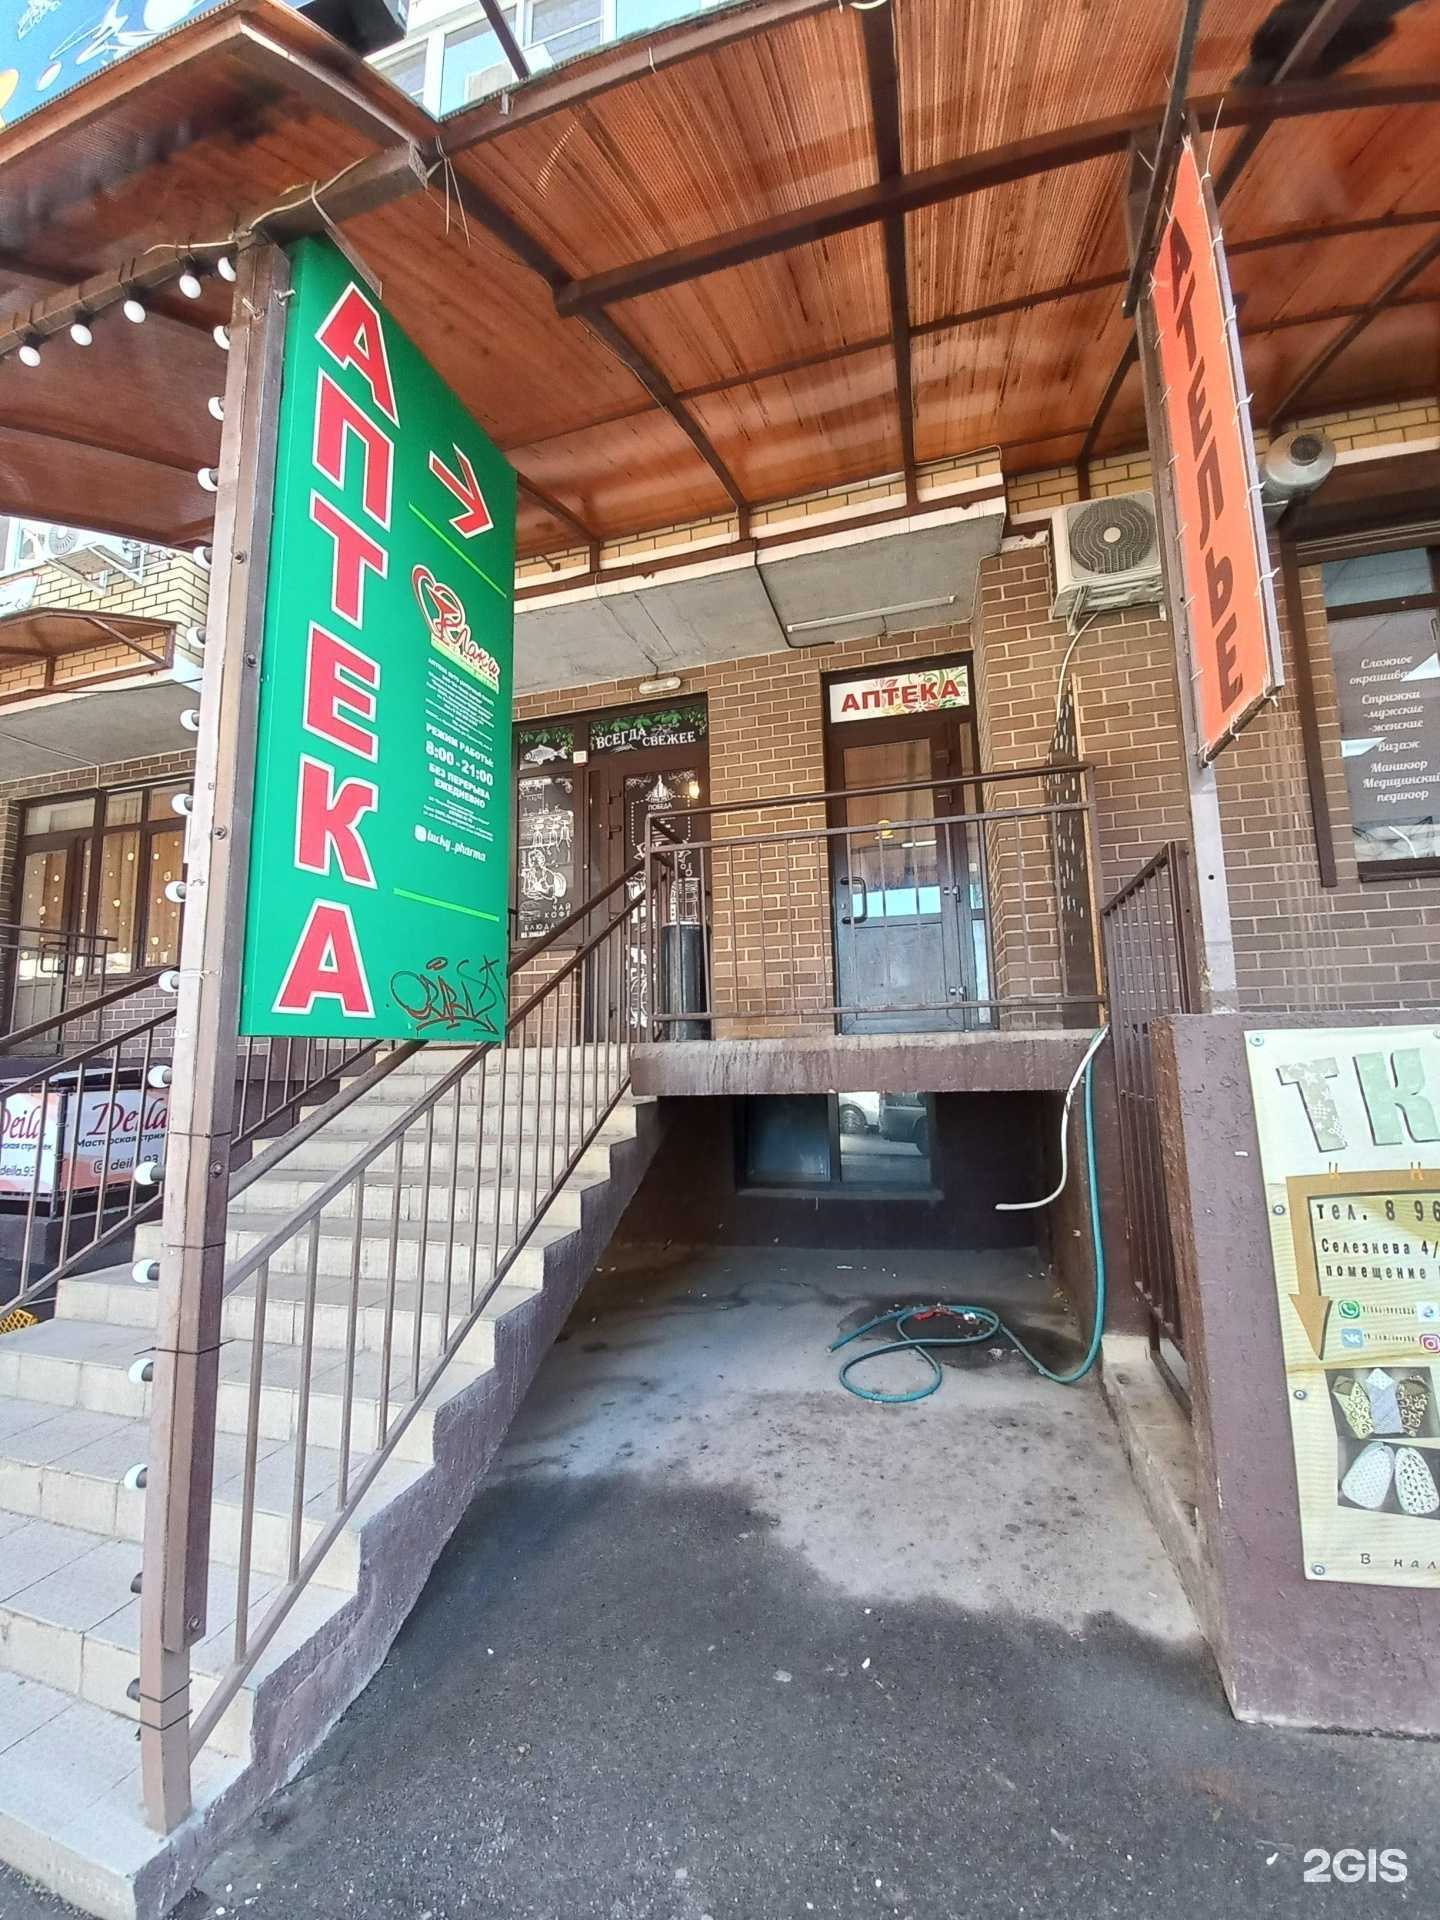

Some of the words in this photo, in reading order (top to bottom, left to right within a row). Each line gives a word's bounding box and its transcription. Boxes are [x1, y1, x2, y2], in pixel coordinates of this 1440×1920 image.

[1169, 215, 1244, 715] АТЕЛЬЕ
[271, 280, 400, 1017] АПТЕКА
[841, 679, 961, 712] АПТЕКА
[1361, 691, 1421, 705] Стрижки
[426, 722, 459, 749] РЕЖИМ
[596, 727, 647, 750] ВСЕГДА
[642, 730, 697, 747] СВЕЖЕЕ
[425, 740, 455, 766] 8:00
[461, 759, 494, 787] 21:00
[428, 762, 447, 779] БЕЗ
[1371, 760, 1429, 773] Маникюр
[434, 777, 486, 808] ЕЖЕДНЕВНО
[1376, 790, 1429, 804] педикюр
[552, 902, 571, 911] ЧАЙ
[86, 1097, 168, 1136] Dela
[1316, 1203, 1368, 1221] тел.
[1384, 1199, 1396, 1221] 8
[1321, 1237, 1411, 1255] Селезнева
[1325, 1265, 1427, 1281] помещение
[1360, 1552, 1371, 1565] В
